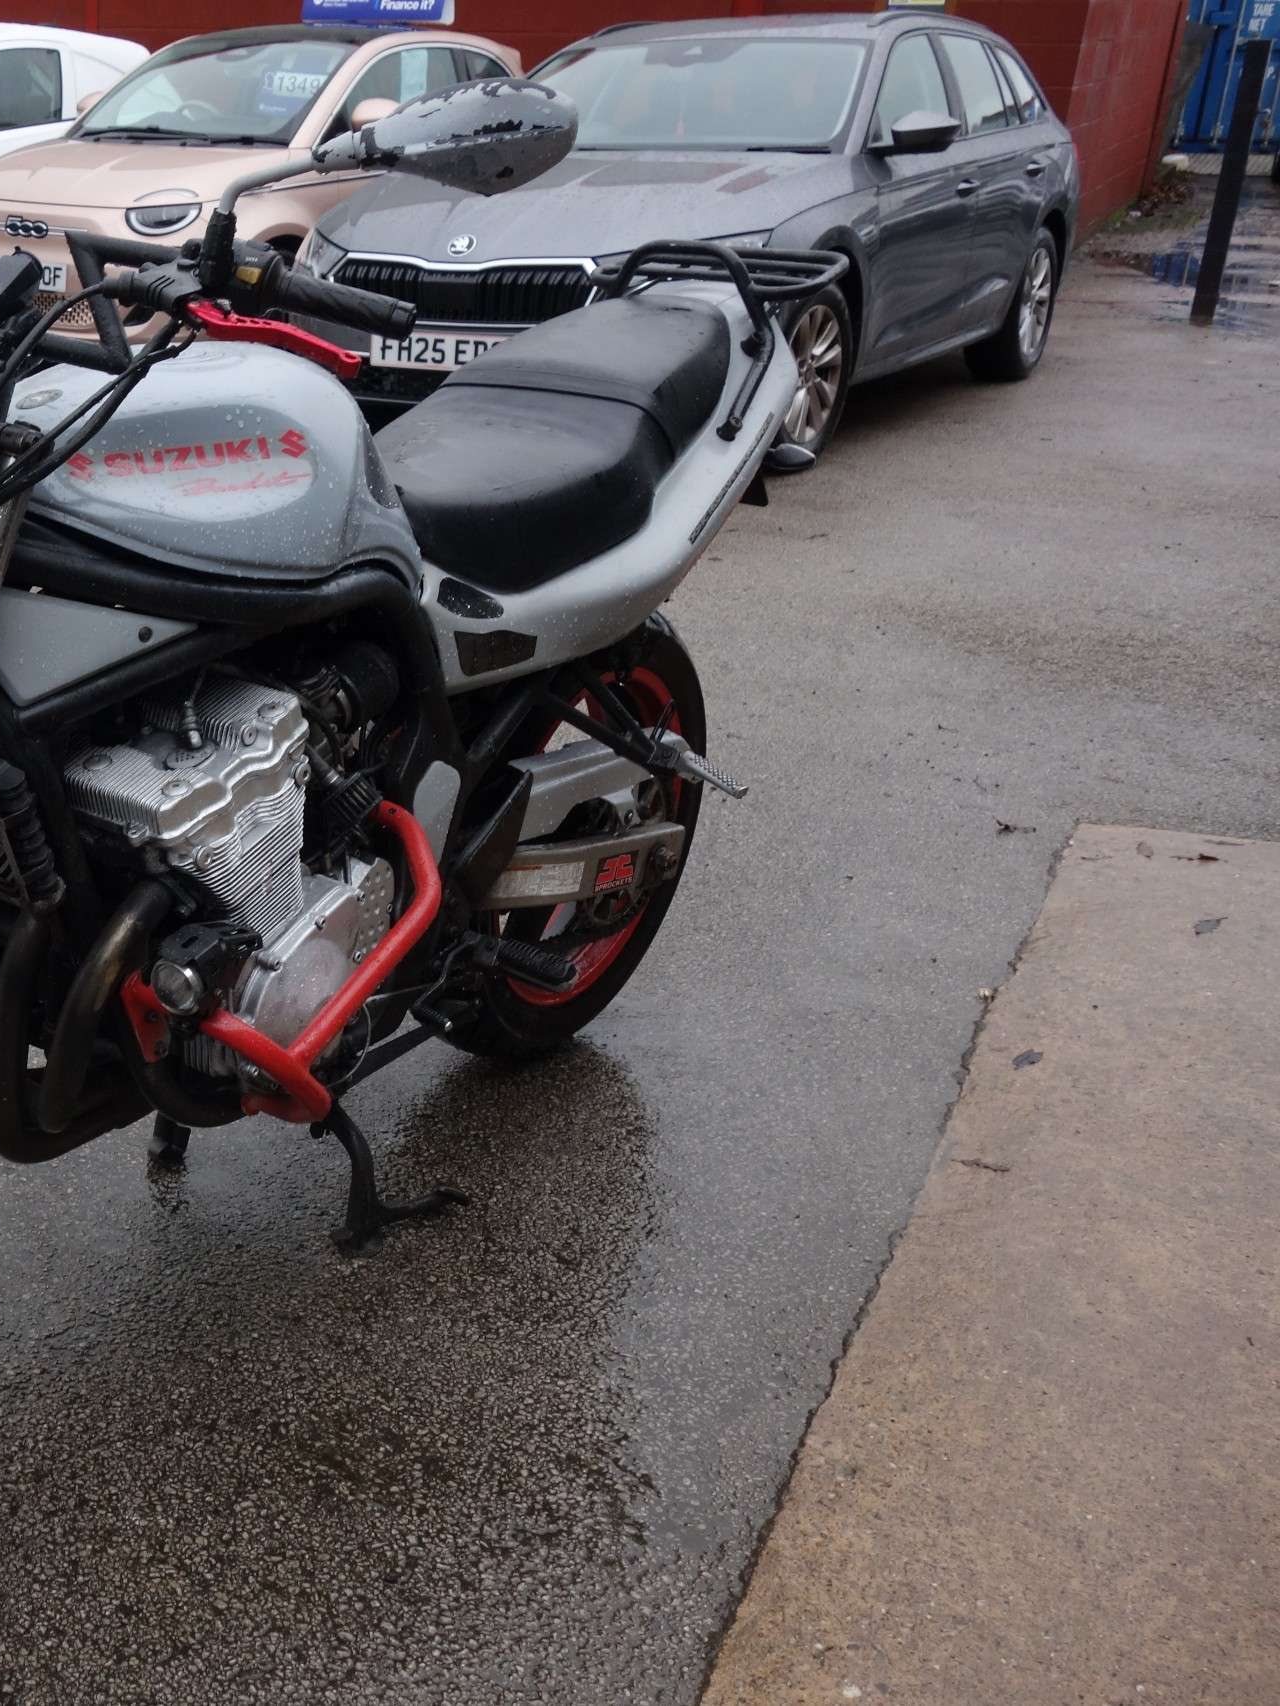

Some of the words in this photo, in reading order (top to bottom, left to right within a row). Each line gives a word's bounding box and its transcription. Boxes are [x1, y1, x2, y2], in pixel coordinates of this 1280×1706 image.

[380, 0, 419, 11] Finance
[1253, 3, 1275, 17] TARE
[1248, 17, 1268, 32] NET
[381, 337, 446, 364] FH25
[103, 436, 271, 478] SUZUKI
